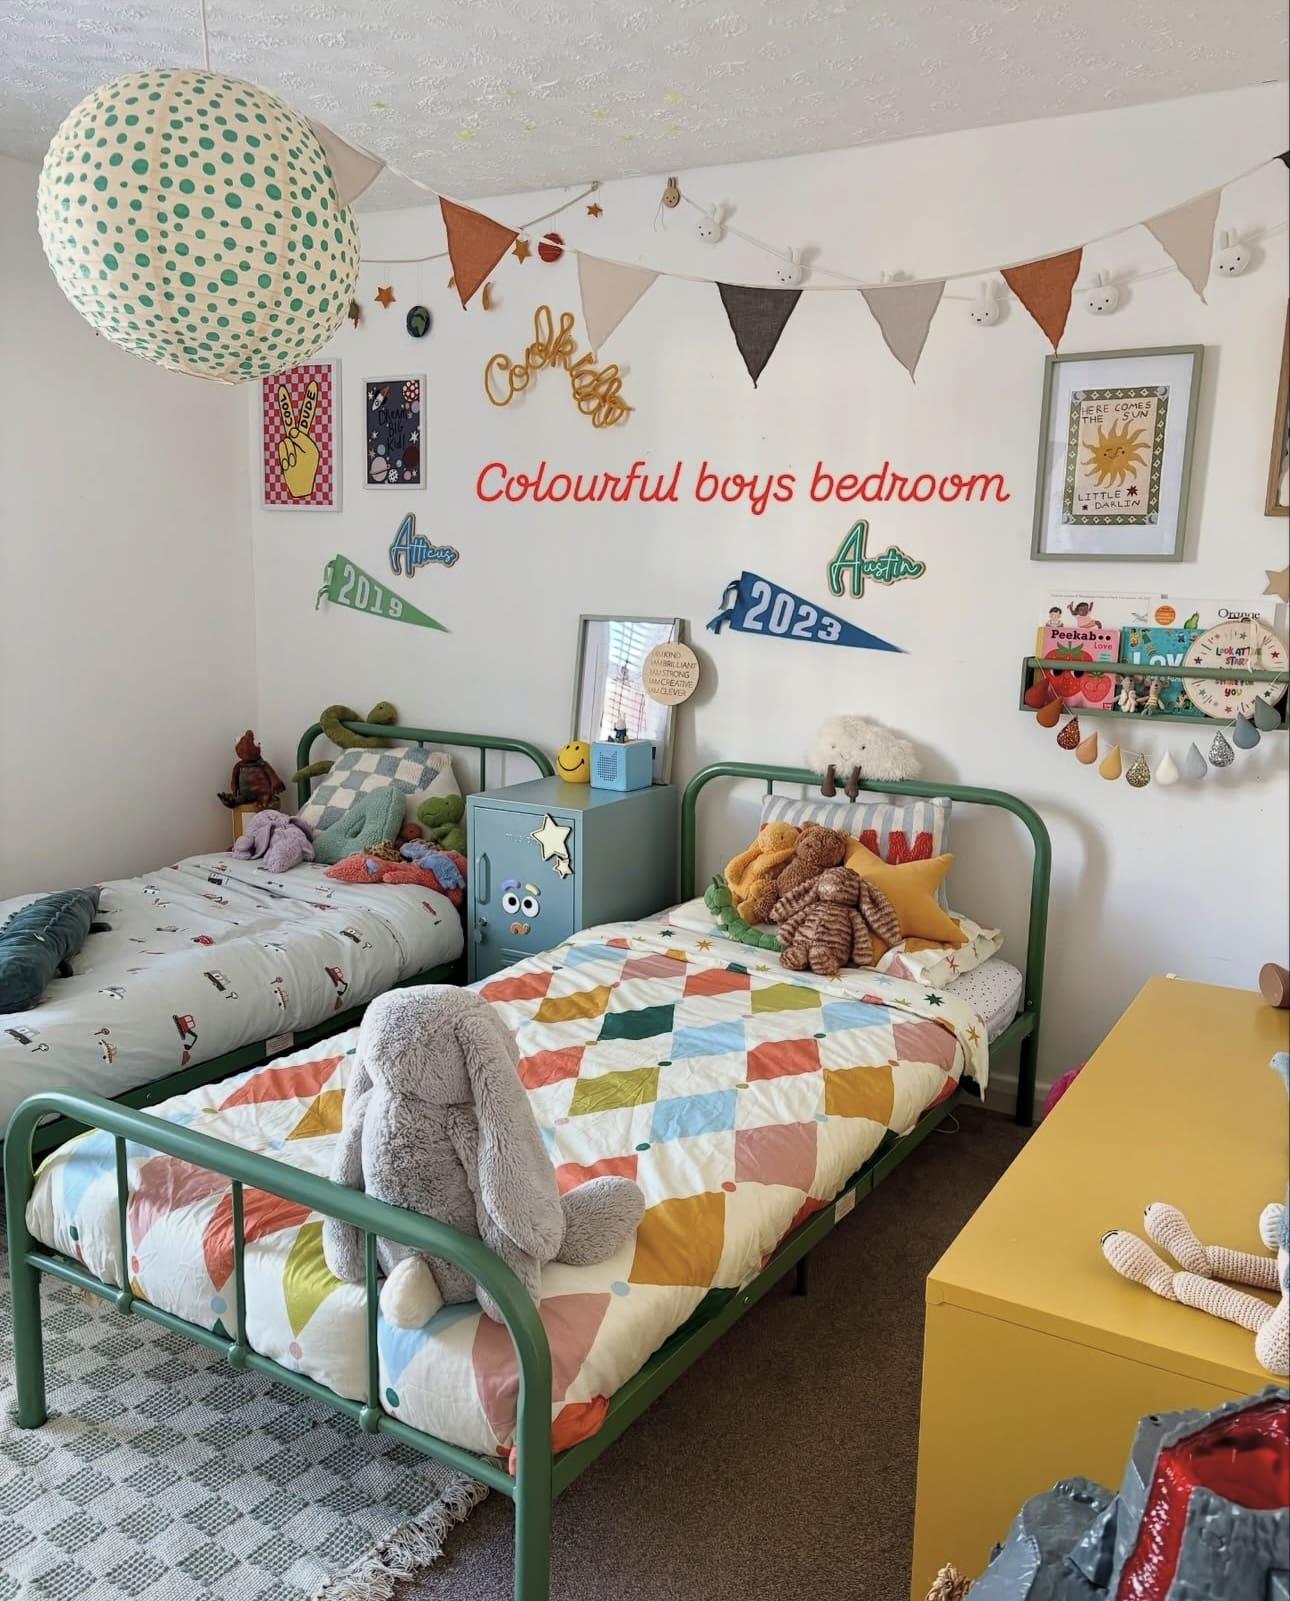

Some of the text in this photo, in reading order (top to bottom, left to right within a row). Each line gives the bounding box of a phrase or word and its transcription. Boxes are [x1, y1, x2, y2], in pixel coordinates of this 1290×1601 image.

[280, 393, 293, 427] COOL
[300, 390, 316, 429] DUDE
[1082, 401, 1151, 416] HERE COMES
[1082, 411, 1148, 424] THE SUN
[1078, 490, 1121, 502] LITTLE
[1095, 500, 1140, 510] DARLIN
[389, 514, 457, 577] Atticus
[828, 520, 923, 597] Austin
[337, 563, 404, 618] 2019
[742, 580, 842, 642] 2023
[663, 661, 696, 669] BRILLIANT
[662, 669, 690, 679] STRONG
[660, 678, 695, 689] CREATIVE
